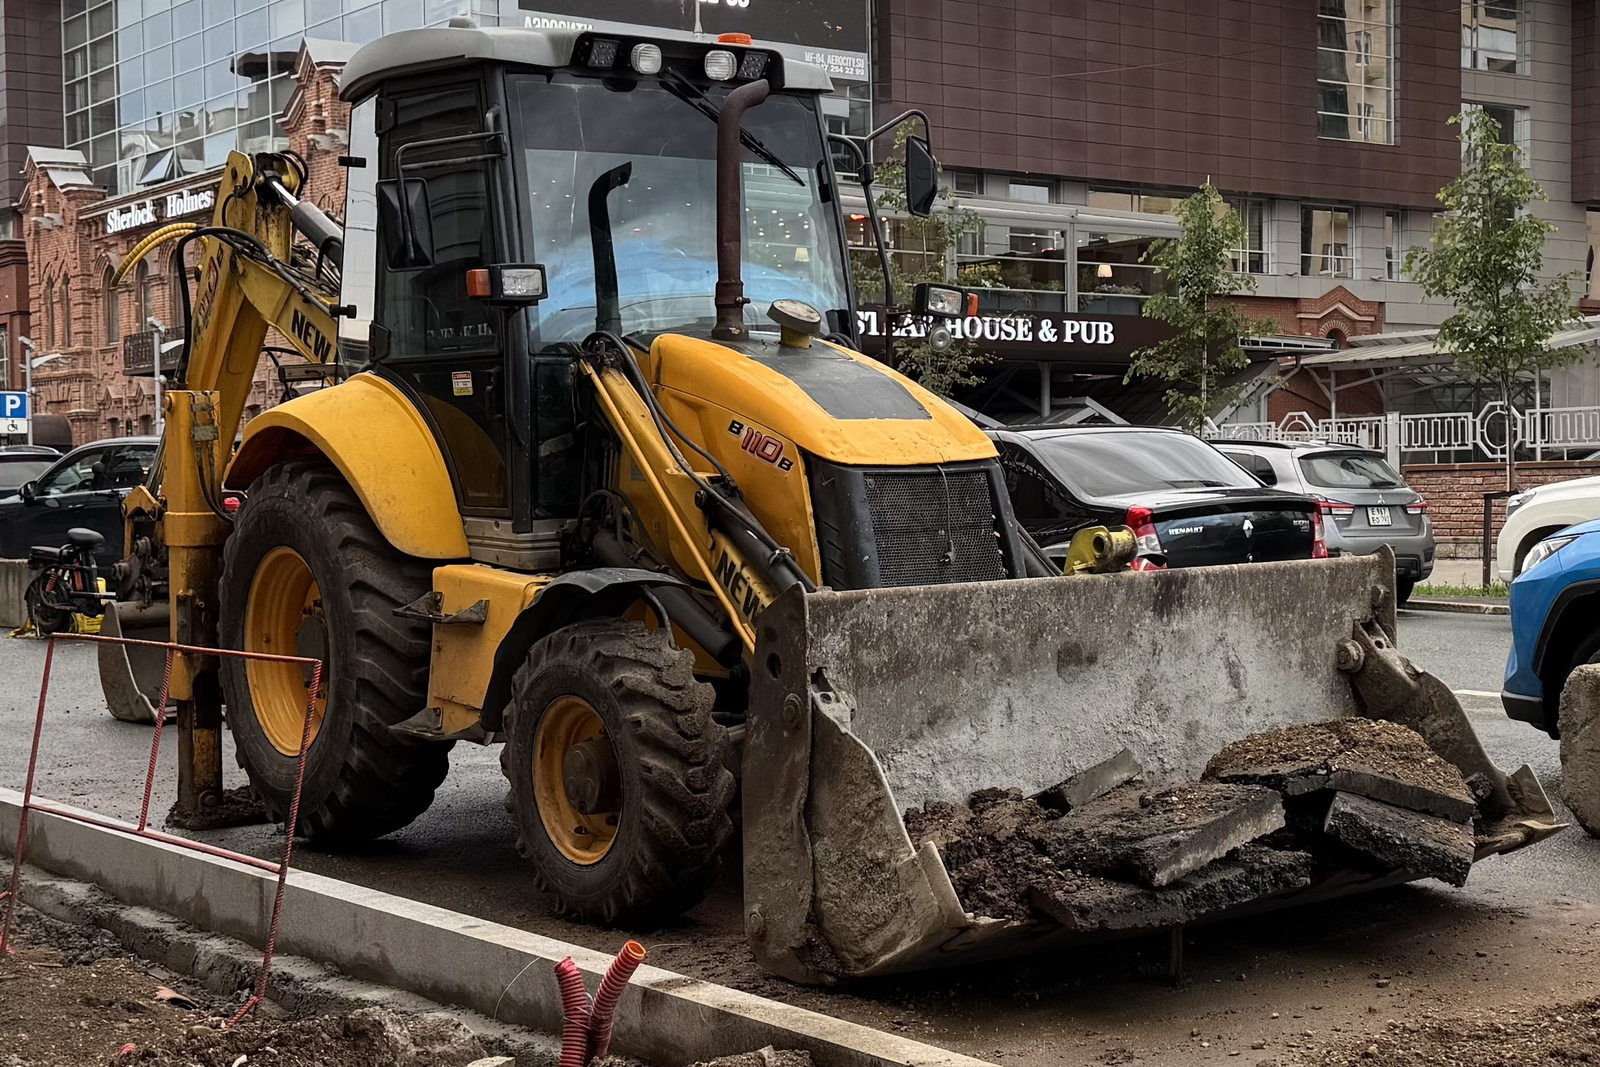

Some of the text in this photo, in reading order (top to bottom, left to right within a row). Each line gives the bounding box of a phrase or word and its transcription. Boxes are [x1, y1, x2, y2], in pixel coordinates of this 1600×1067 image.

[106, 189, 214, 234] Sherlock Holmes
[291, 308, 333, 365] NEW
[945, 315, 1033, 342] HOUSE
[1038, 318, 1058, 343] &
[1063, 320, 1115, 345] PUB
[5, 395, 21, 417] P
[716, 550, 766, 629] NEW
